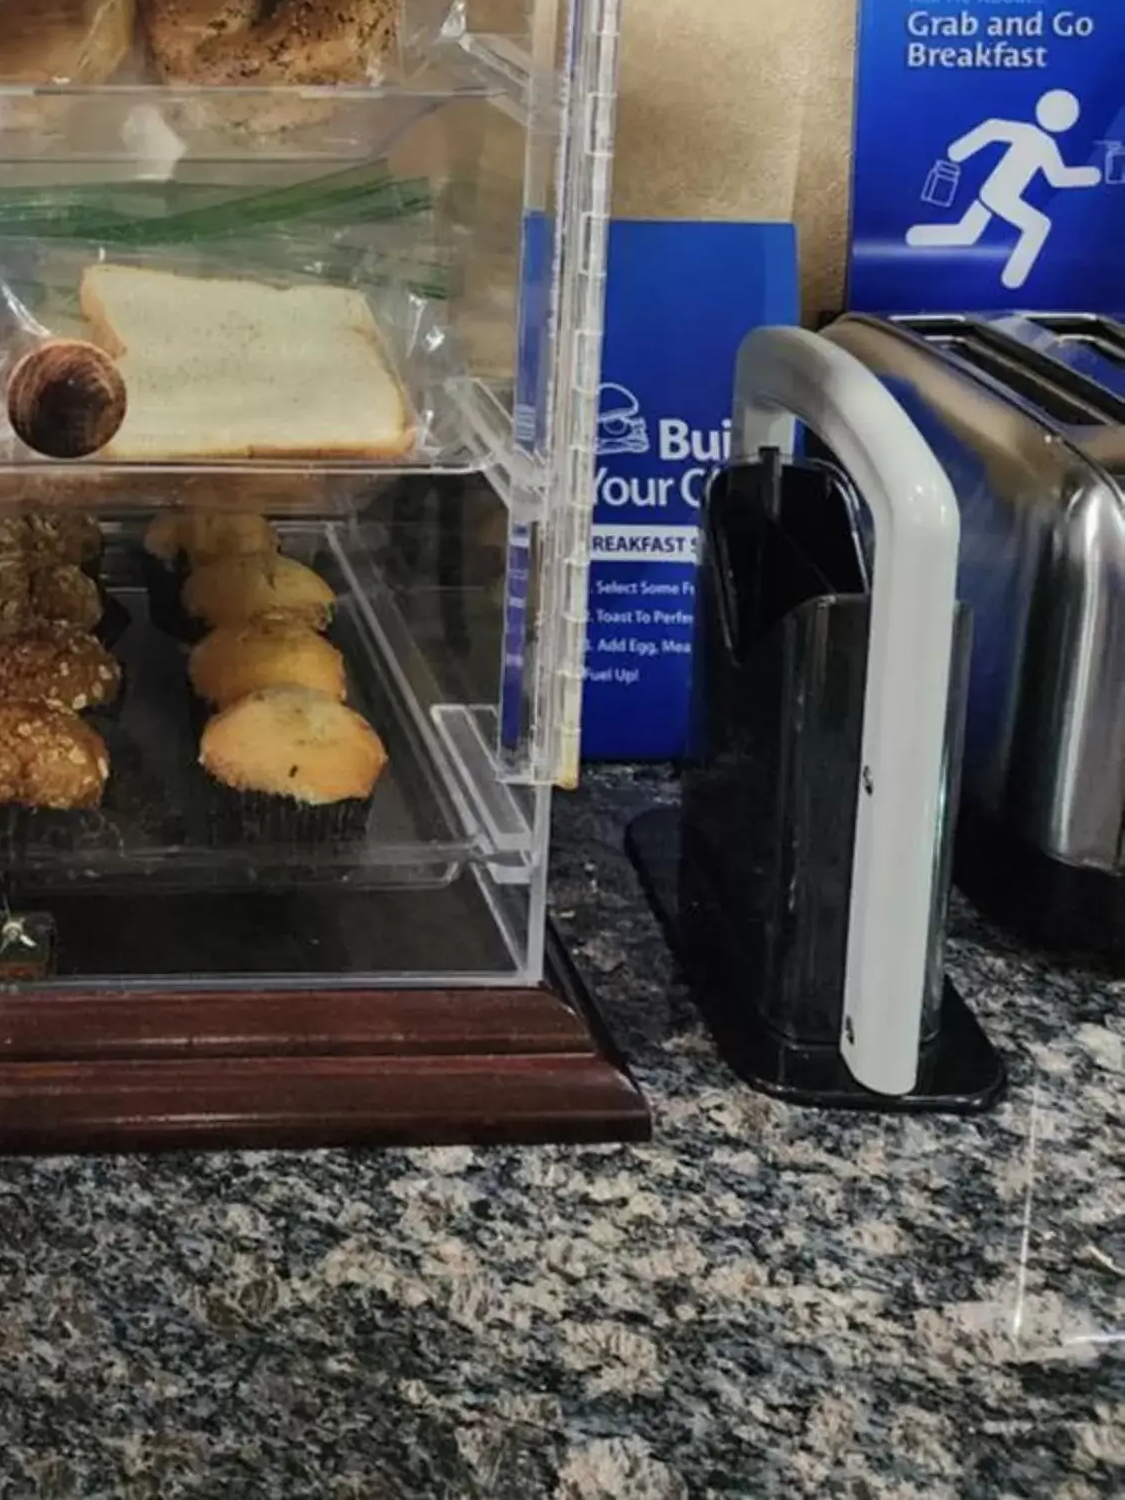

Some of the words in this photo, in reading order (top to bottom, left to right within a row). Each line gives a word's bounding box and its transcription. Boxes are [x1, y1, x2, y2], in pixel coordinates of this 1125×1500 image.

[907, 10, 979, 37] Grab
[987, 10, 1043, 37] and
[1052, 11, 1094, 37] Go
[907, 41, 1048, 68] Breakfast
[596, 580, 638, 595] Select
[641, 581, 680, 595] Some
[596, 609, 632, 624] Toast
[635, 610, 651, 624] To
[597, 639, 626, 653] Add
